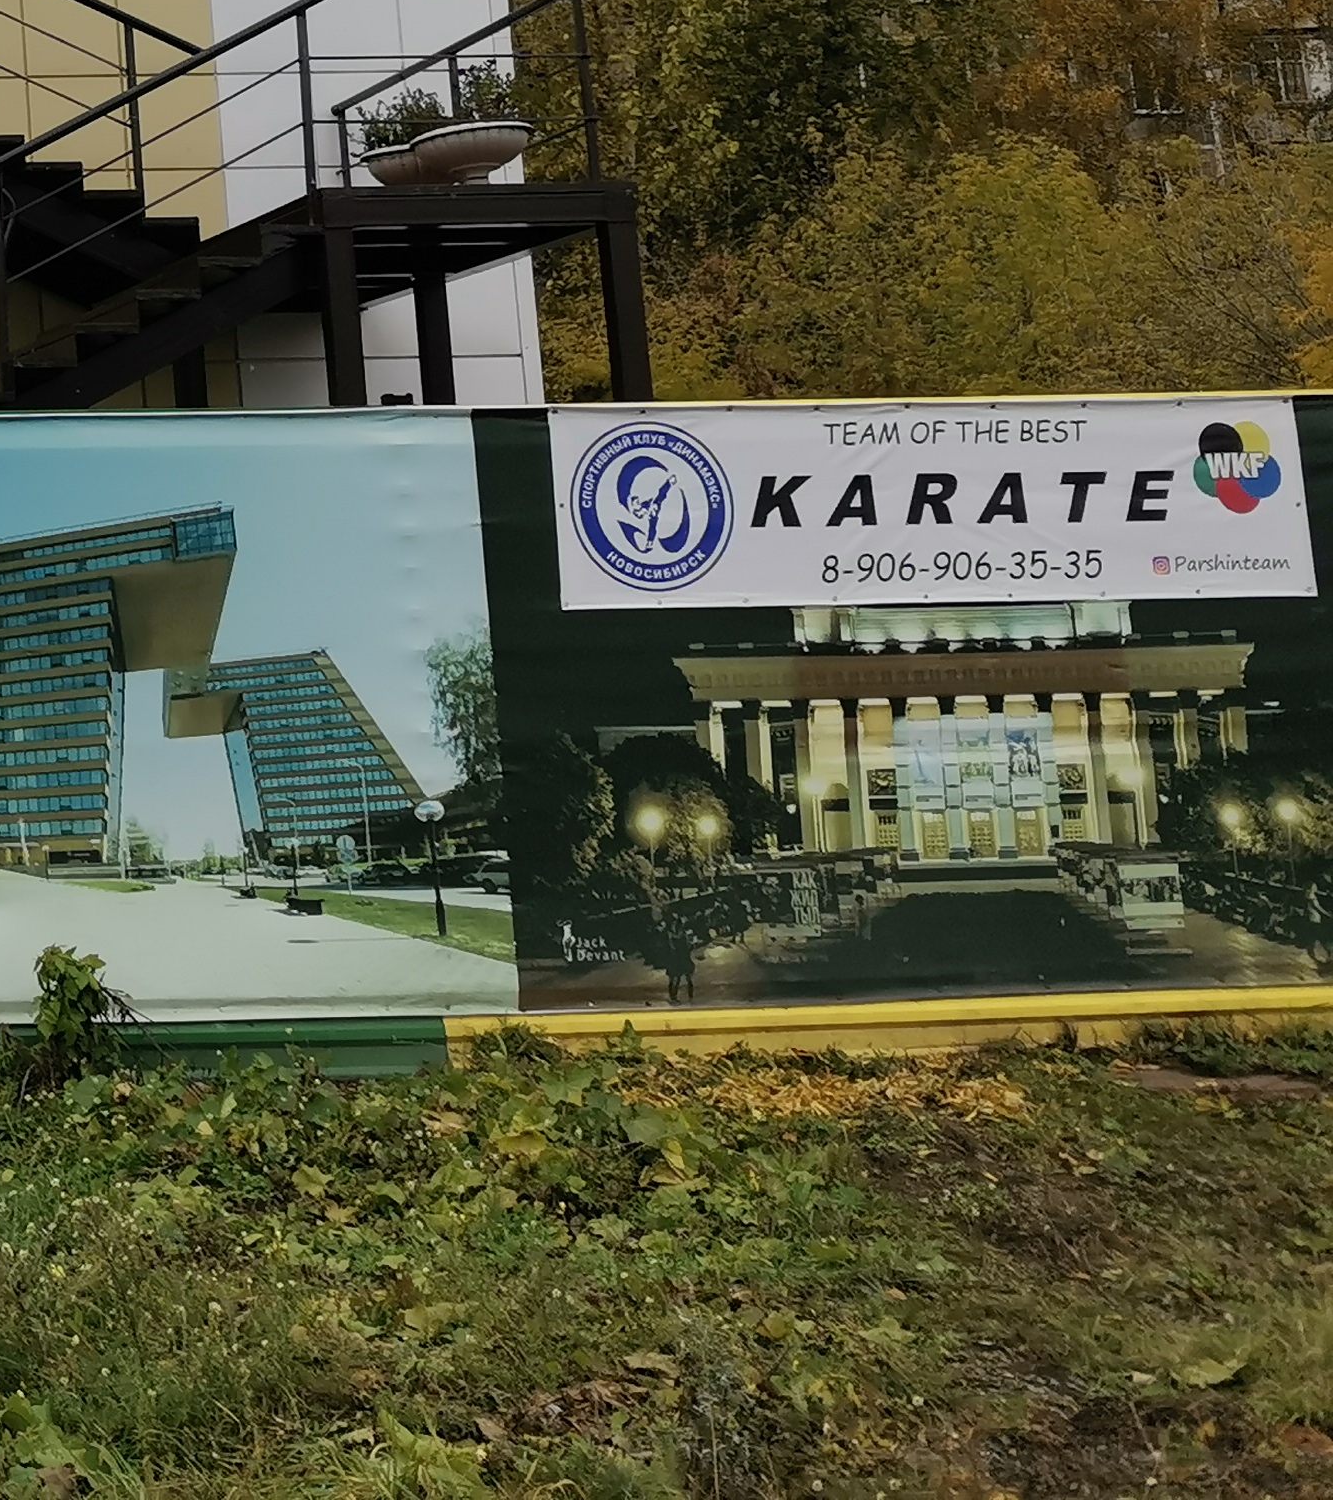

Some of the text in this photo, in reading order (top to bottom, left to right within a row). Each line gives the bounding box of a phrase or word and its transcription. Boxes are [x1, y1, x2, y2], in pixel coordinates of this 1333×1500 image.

[823, 419, 1087, 446] TEAM OF THE BEST
[581, 434, 632, 508] СПОРТИВНЫЙ
[633, 434, 666, 446] КЛУБ
[1206, 452, 1266, 479] WKF
[750, 470, 1175, 528] KARATE
[606, 550, 706, 579] НОВОСИБИРСК
[822, 550, 1103, 583] 8-906-906-35-35
[1174, 554, 1291, 572] Parshinteam
[576, 935, 607, 950] Jack
[576, 948, 626, 961] Devant
